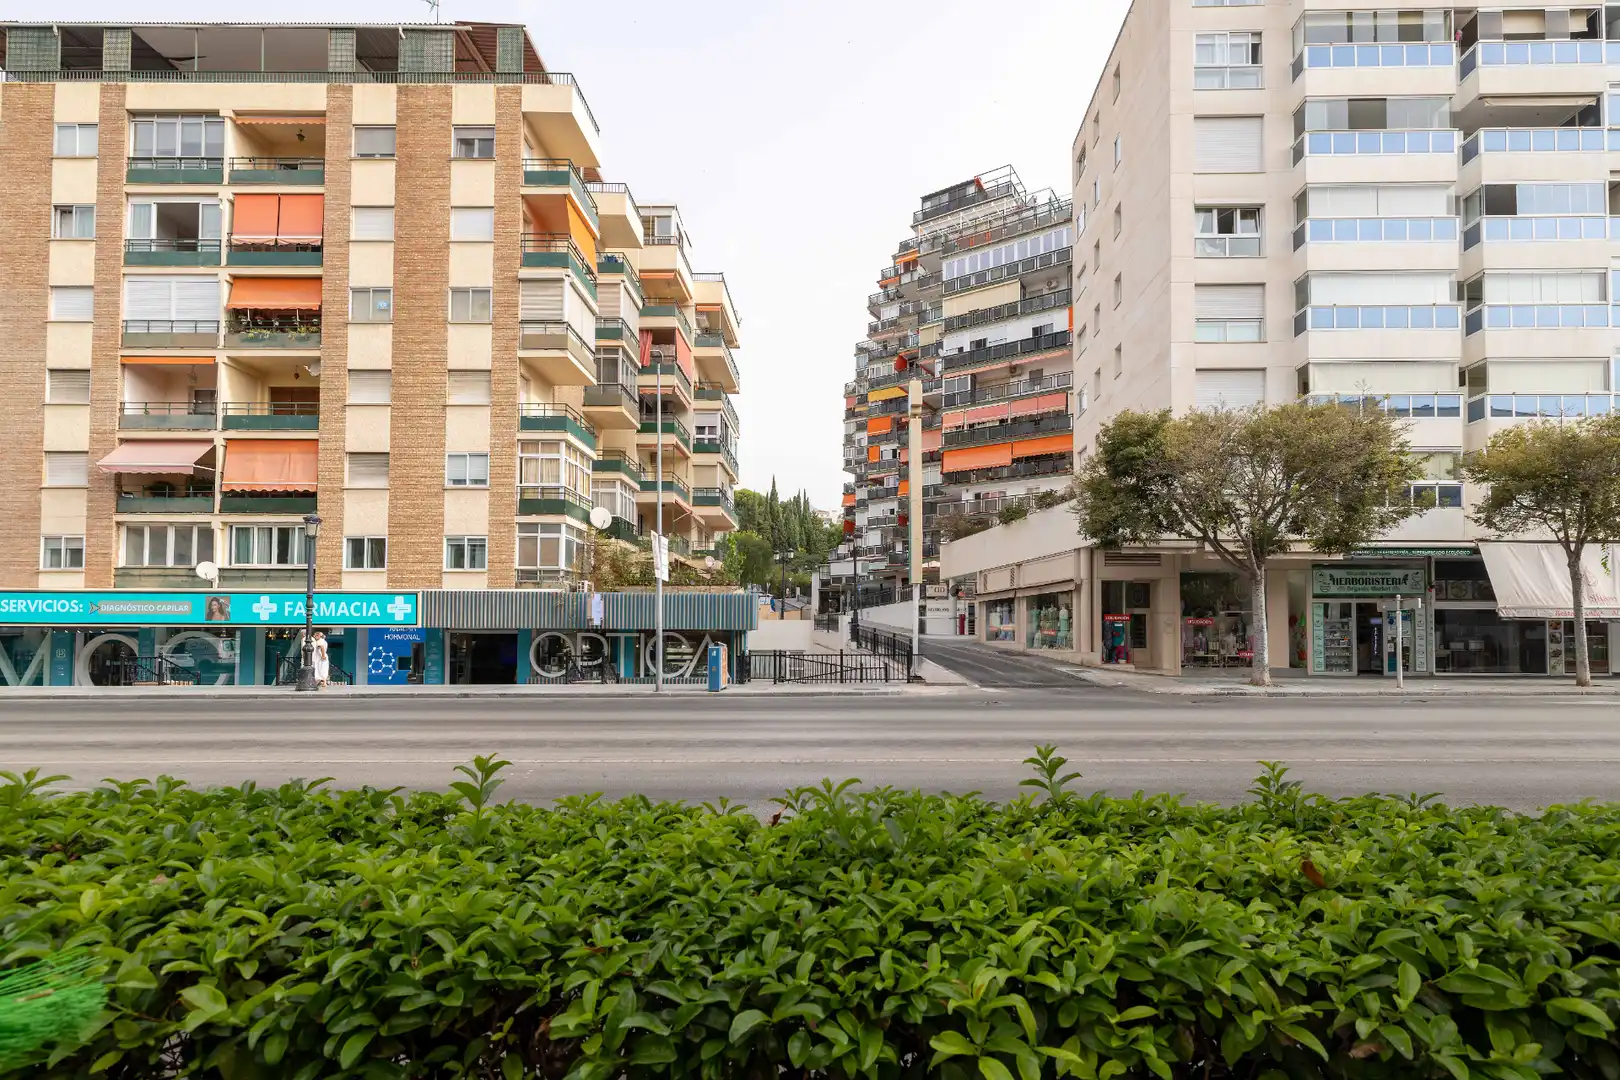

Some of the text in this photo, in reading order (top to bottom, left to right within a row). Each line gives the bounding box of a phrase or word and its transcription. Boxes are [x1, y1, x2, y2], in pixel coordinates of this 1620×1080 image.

[0, 600, 83, 613] SERVICIOS:
[101, 603, 189, 612] DIAGNÓSTICO CAPILAR
[284, 601, 381, 616] FARMACIA
